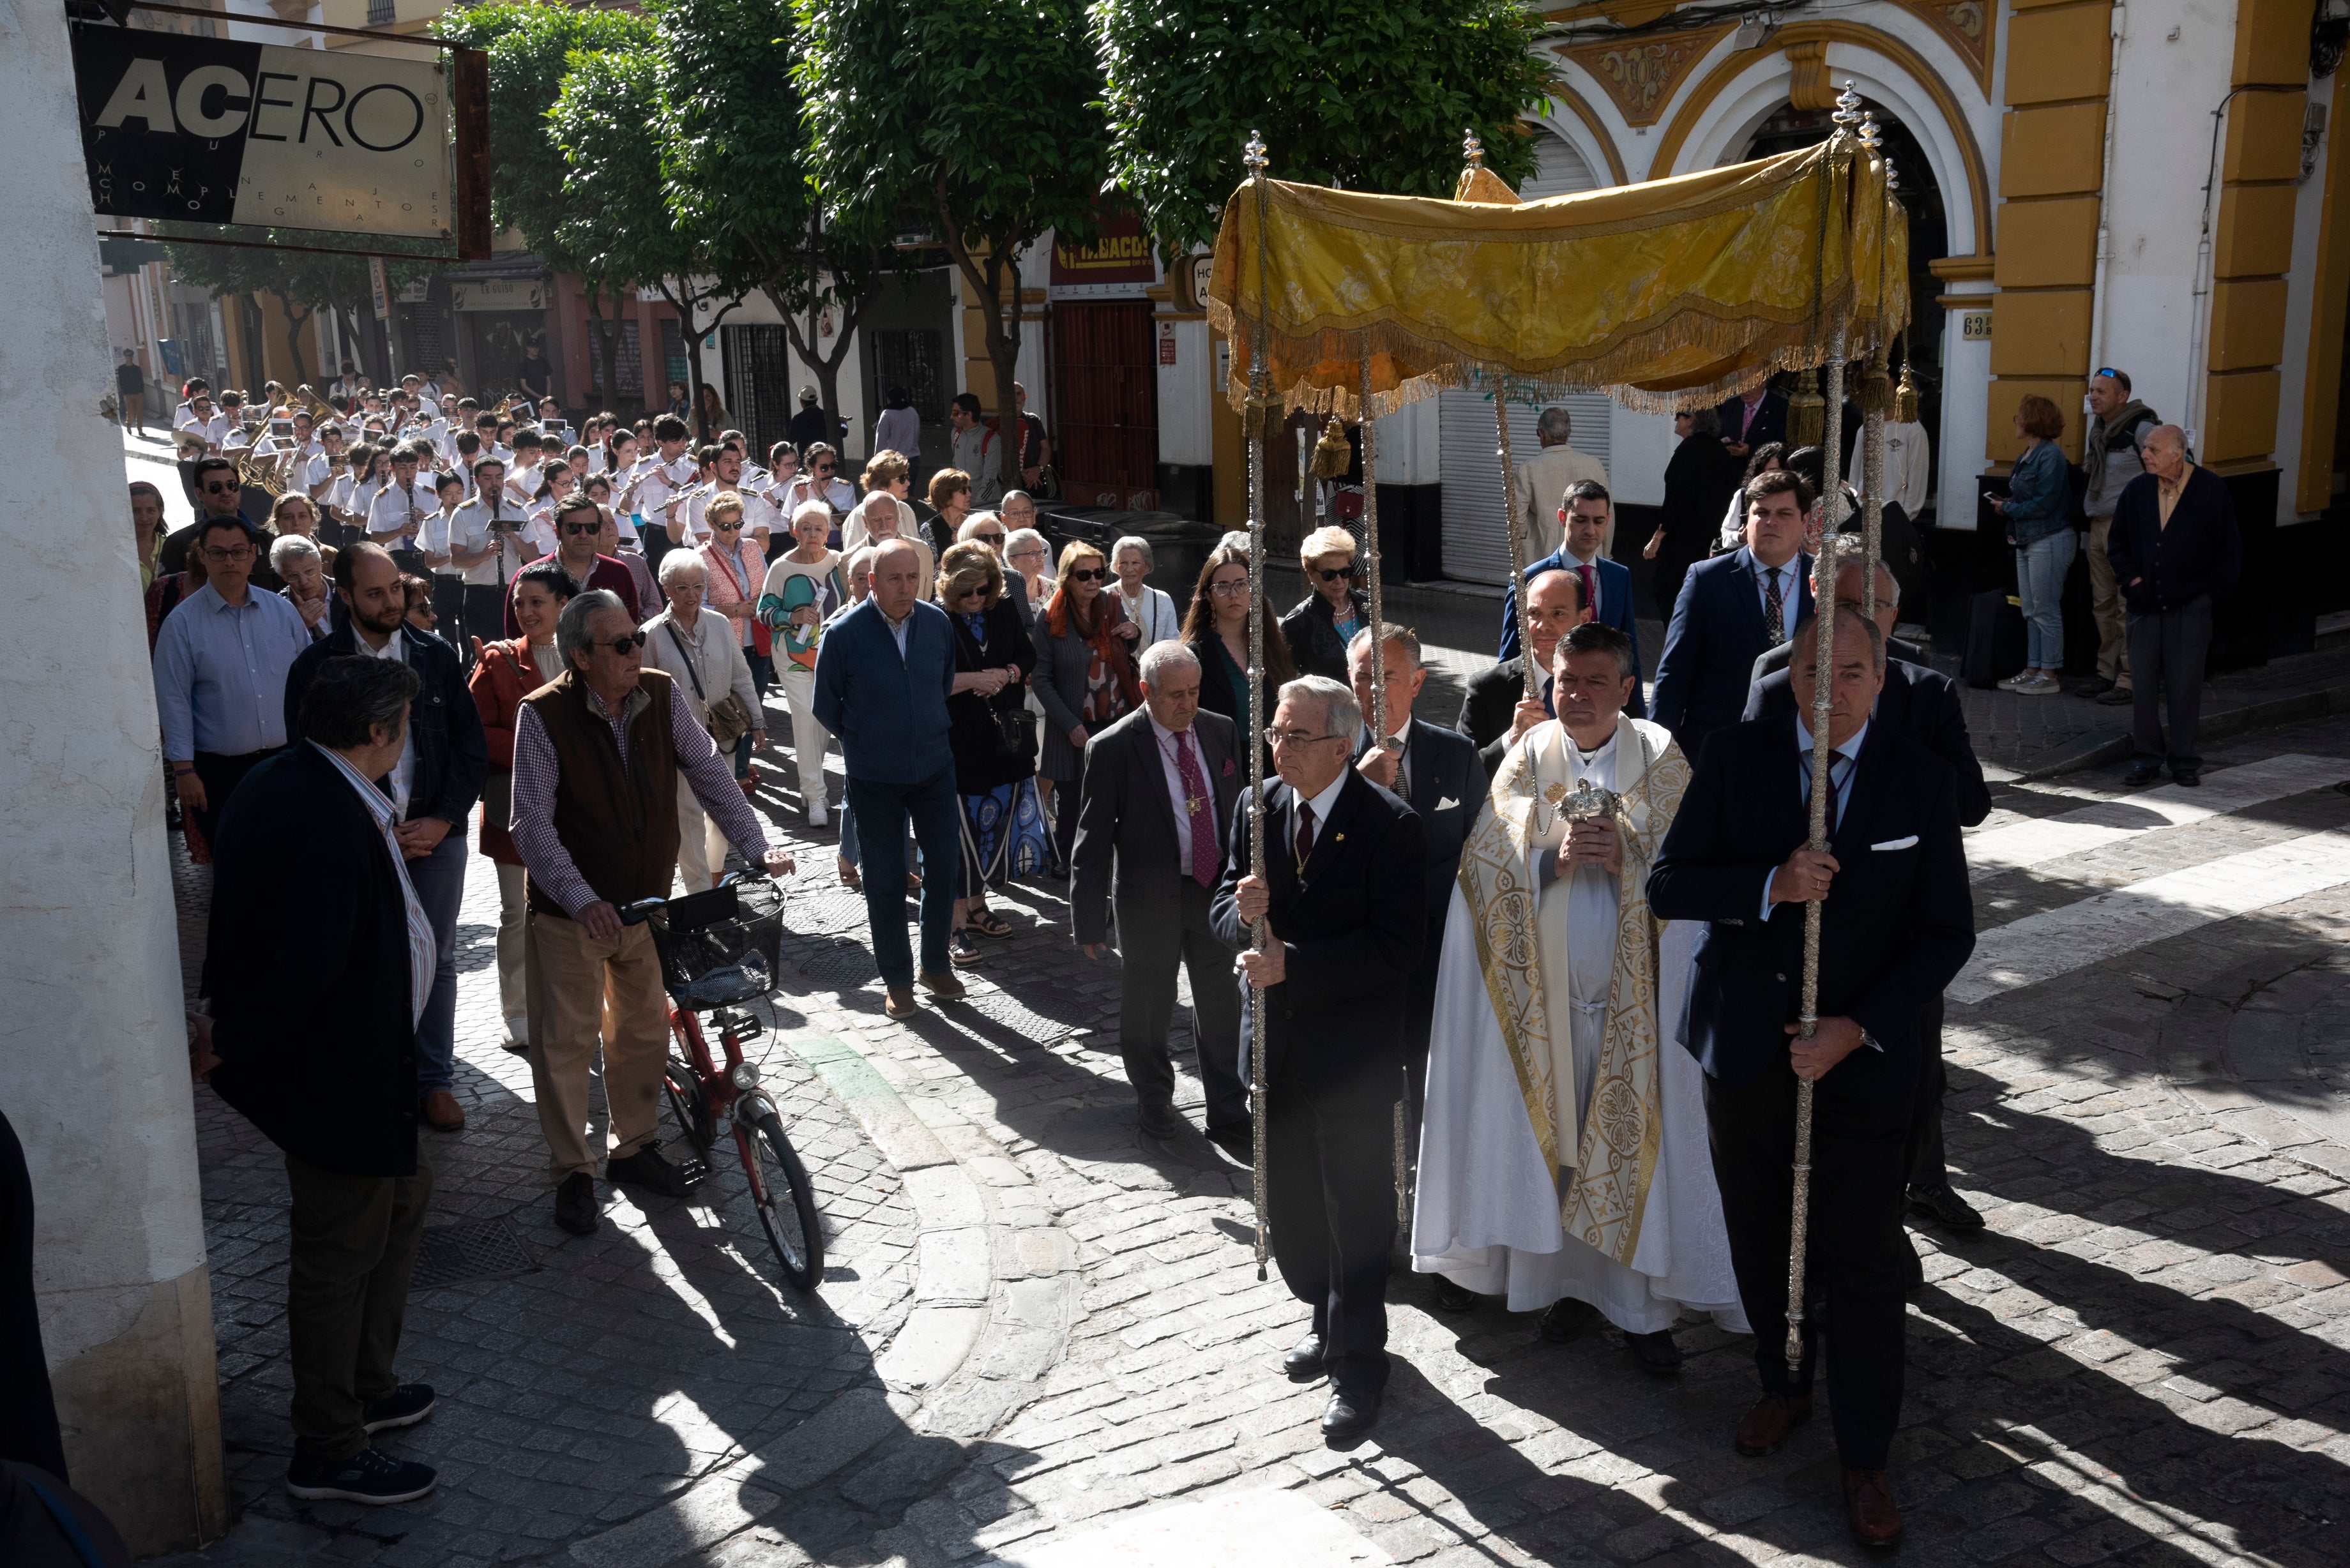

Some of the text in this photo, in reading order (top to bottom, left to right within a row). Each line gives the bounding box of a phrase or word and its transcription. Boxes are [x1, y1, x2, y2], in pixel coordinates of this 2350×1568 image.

[95, 57, 424, 152] ACERO
[481, 283, 514, 294] ER GUISO
[1964, 317, 1983, 335] 63
